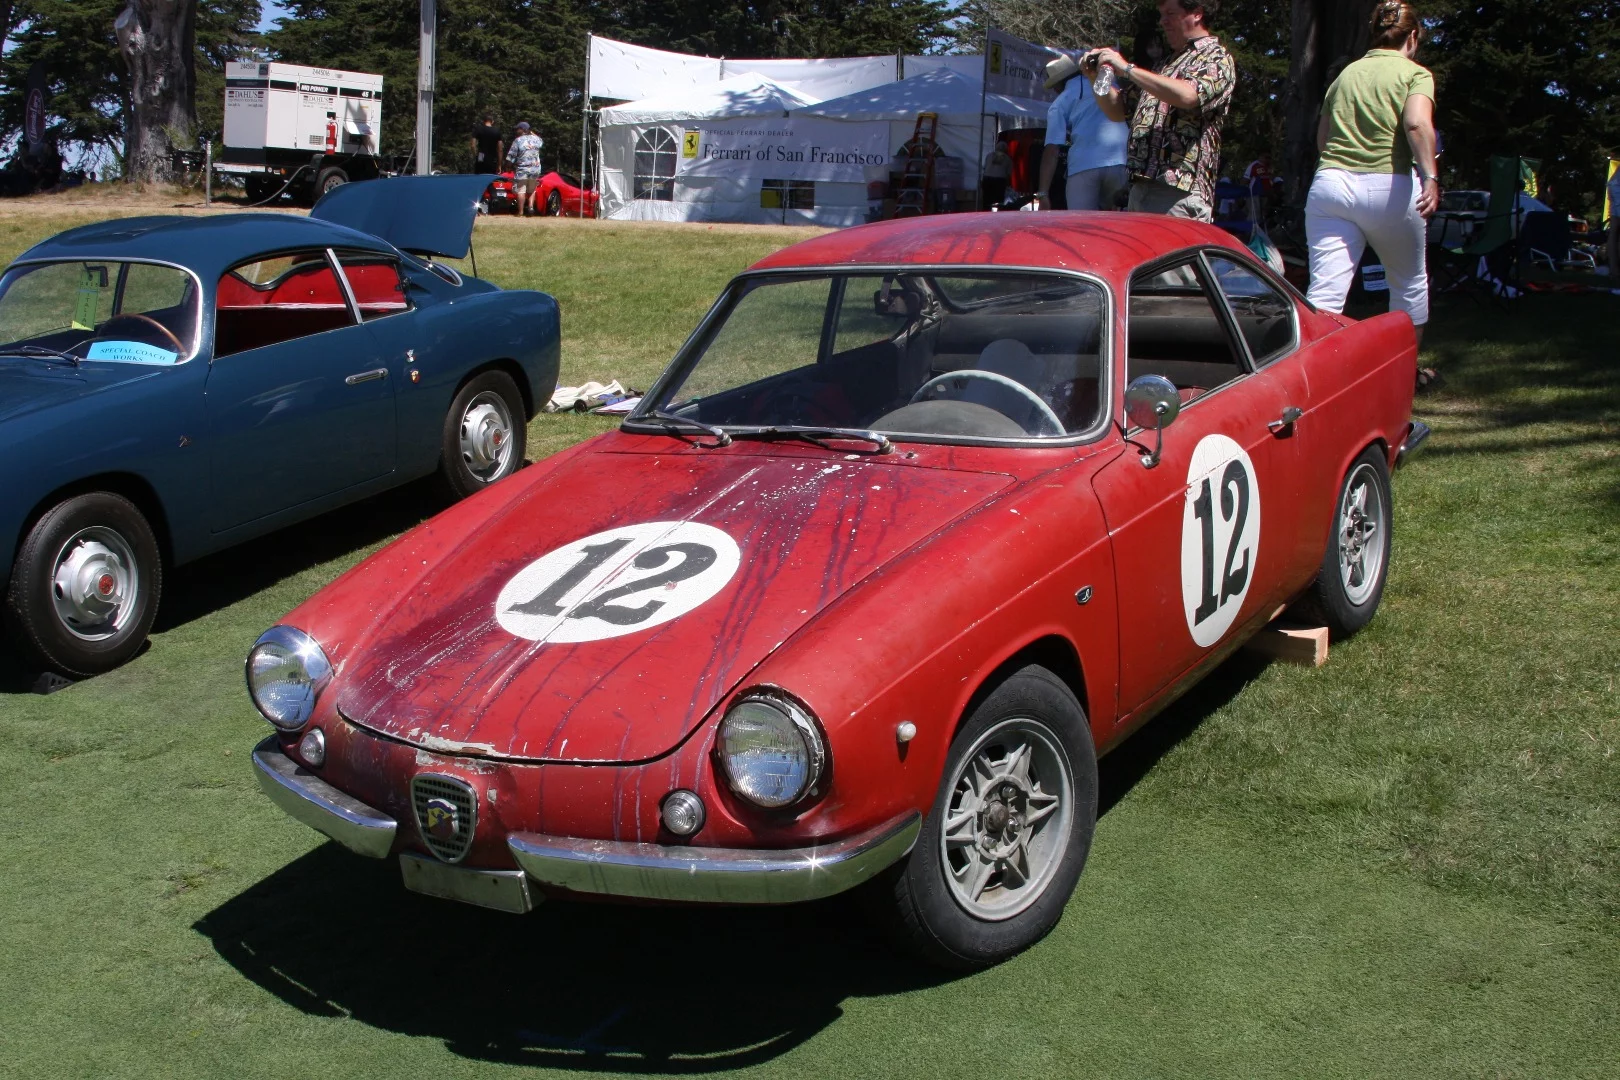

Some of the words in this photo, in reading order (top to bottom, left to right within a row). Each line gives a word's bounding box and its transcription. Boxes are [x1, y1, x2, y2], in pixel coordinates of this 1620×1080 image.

[1003, 58, 1034, 81] Ferrari
[310, 85, 329, 93] POWER
[234, 91, 258, 99] DAHL'S
[308, 95, 329, 103] DAHL'S
[704, 129, 735, 137] OFFICIAL
[736, 129, 766, 137] FERRARI
[767, 130, 795, 138] DEALER
[703, 143, 751, 161] Ferrari
[756, 144, 775, 161] of
[776, 144, 804, 162] San
[809, 145, 884, 166] Francisco
[113, 354, 145, 362] WORKS
[135, 349, 166, 361] COACH
[1192, 458, 1251, 628] 12
[506, 536, 718, 627] 12
